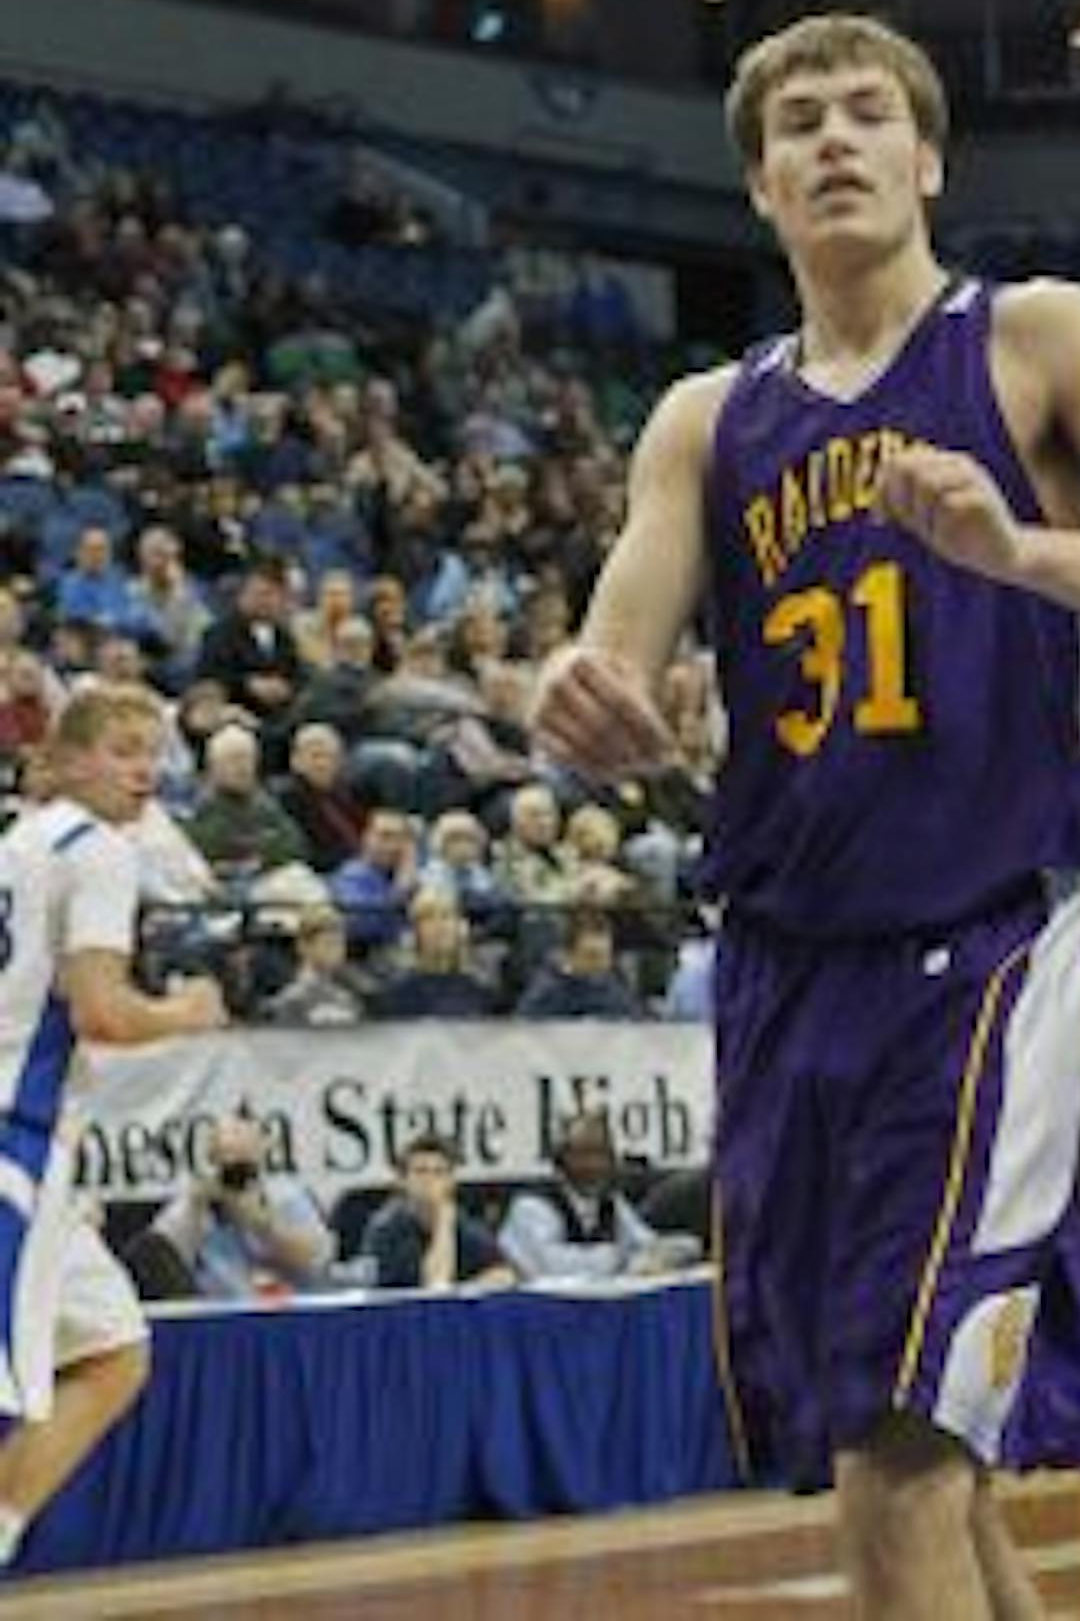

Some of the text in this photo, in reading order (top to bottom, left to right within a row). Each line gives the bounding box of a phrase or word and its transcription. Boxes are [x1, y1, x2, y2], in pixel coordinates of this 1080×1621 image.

[743, 427, 932, 587] RAIDE
[762, 561, 924, 756] 31
[73, 1093, 297, 1187] nesoa
[323, 1078, 506, 1175] State
